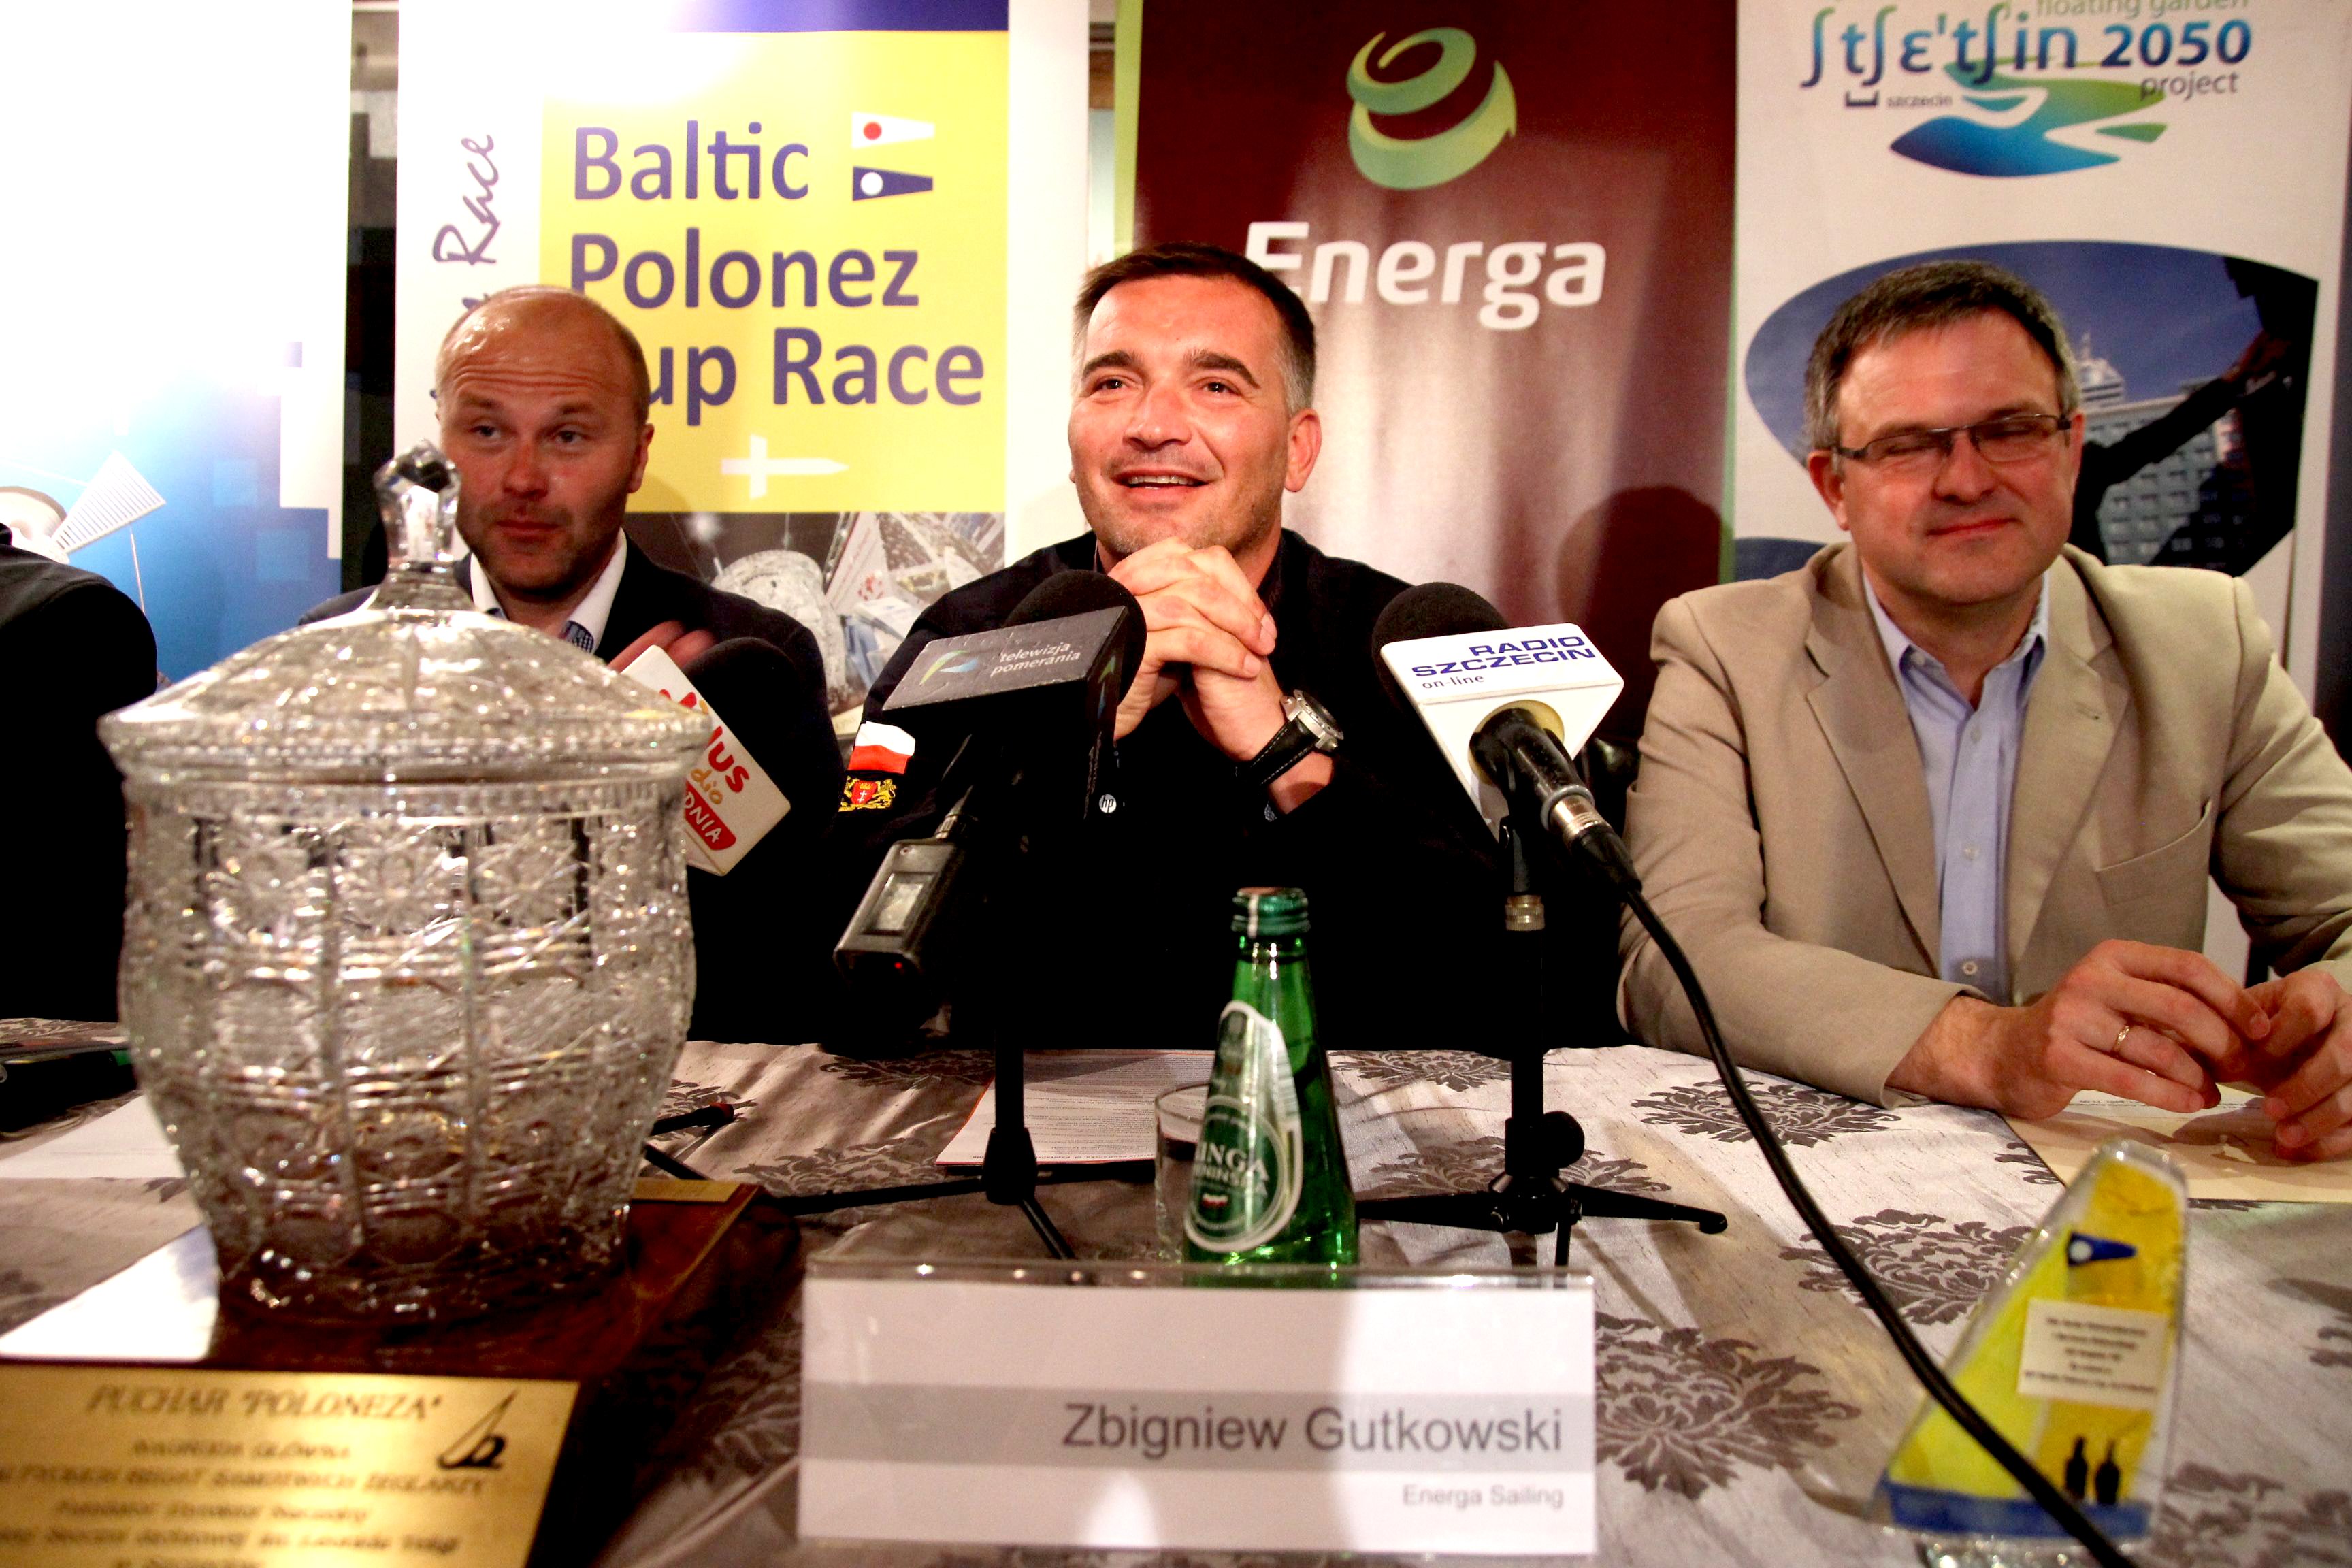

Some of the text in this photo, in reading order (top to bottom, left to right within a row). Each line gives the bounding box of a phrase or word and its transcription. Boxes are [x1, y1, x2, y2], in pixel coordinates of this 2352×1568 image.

[2100, 18, 2252, 67] 2050
[2140, 71, 2239, 101] project
[574, 119, 809, 201] Baltic
[431, 134, 501, 266] Race
[570, 227, 920, 309] Polonez
[1245, 221, 1607, 330] Energa
[649, 327, 985, 427] up Race
[990, 650, 1081, 678] pomerania
[1000, 641, 1071, 663] telewizja
[1411, 648, 1597, 678] SZCZECIN
[1468, 636, 1586, 657] RADIO
[1100, 794, 1115, 813] hp
[1063, 1402, 1562, 1461] Zbigniew Gutkowski
[1403, 1483, 1565, 1511] Energa Sailing
